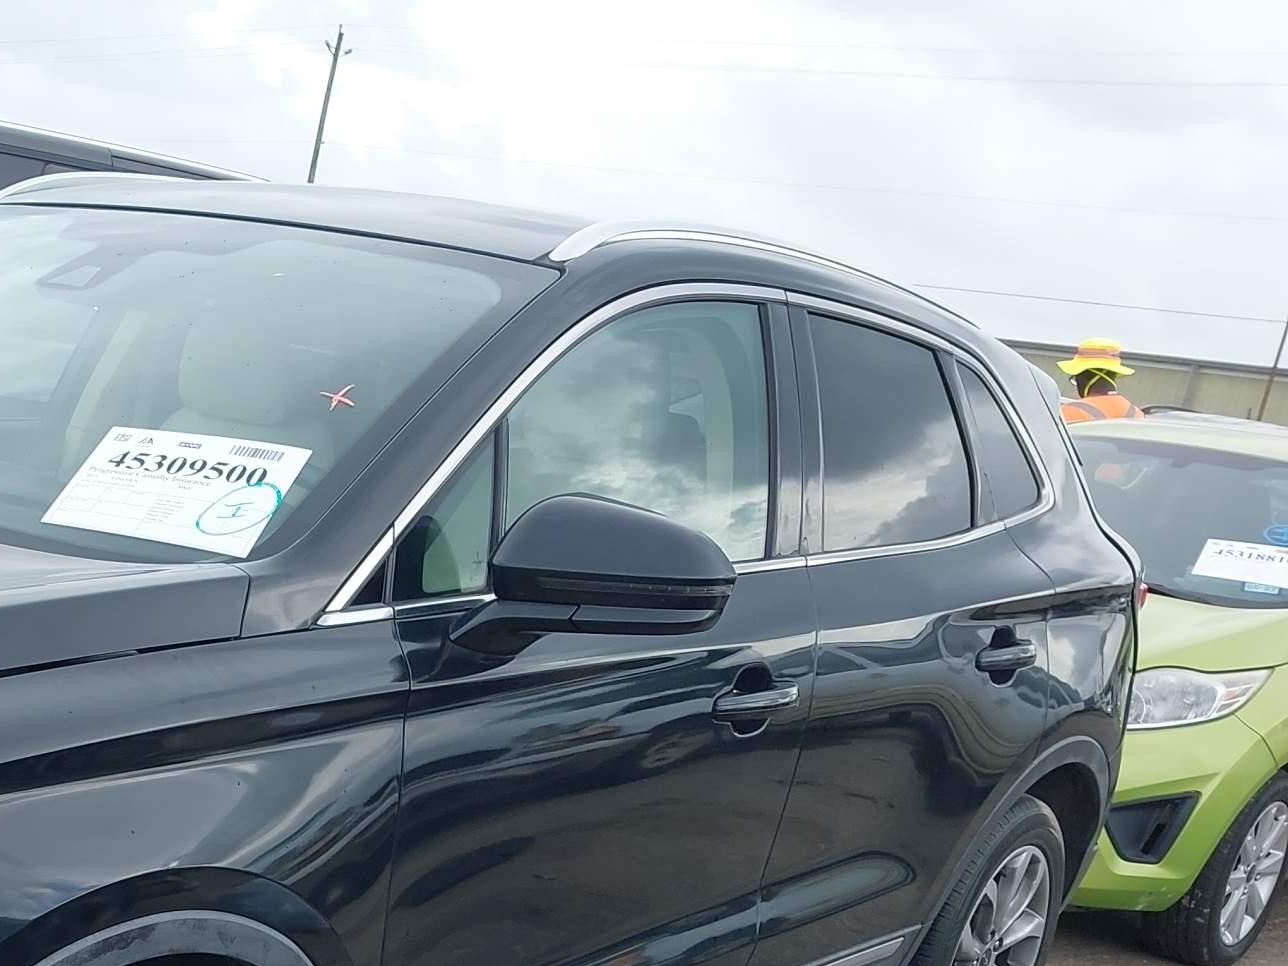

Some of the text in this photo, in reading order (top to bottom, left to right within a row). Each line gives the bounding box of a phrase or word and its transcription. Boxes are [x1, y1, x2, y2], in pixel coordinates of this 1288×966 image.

[88, 465, 136, 478] Progressive
[136, 471, 171, 483] Casualty
[171, 475, 213, 488] Insurance
[107, 450, 268, 487] 45309500
[1213, 549, 1288, 564] 4531881
